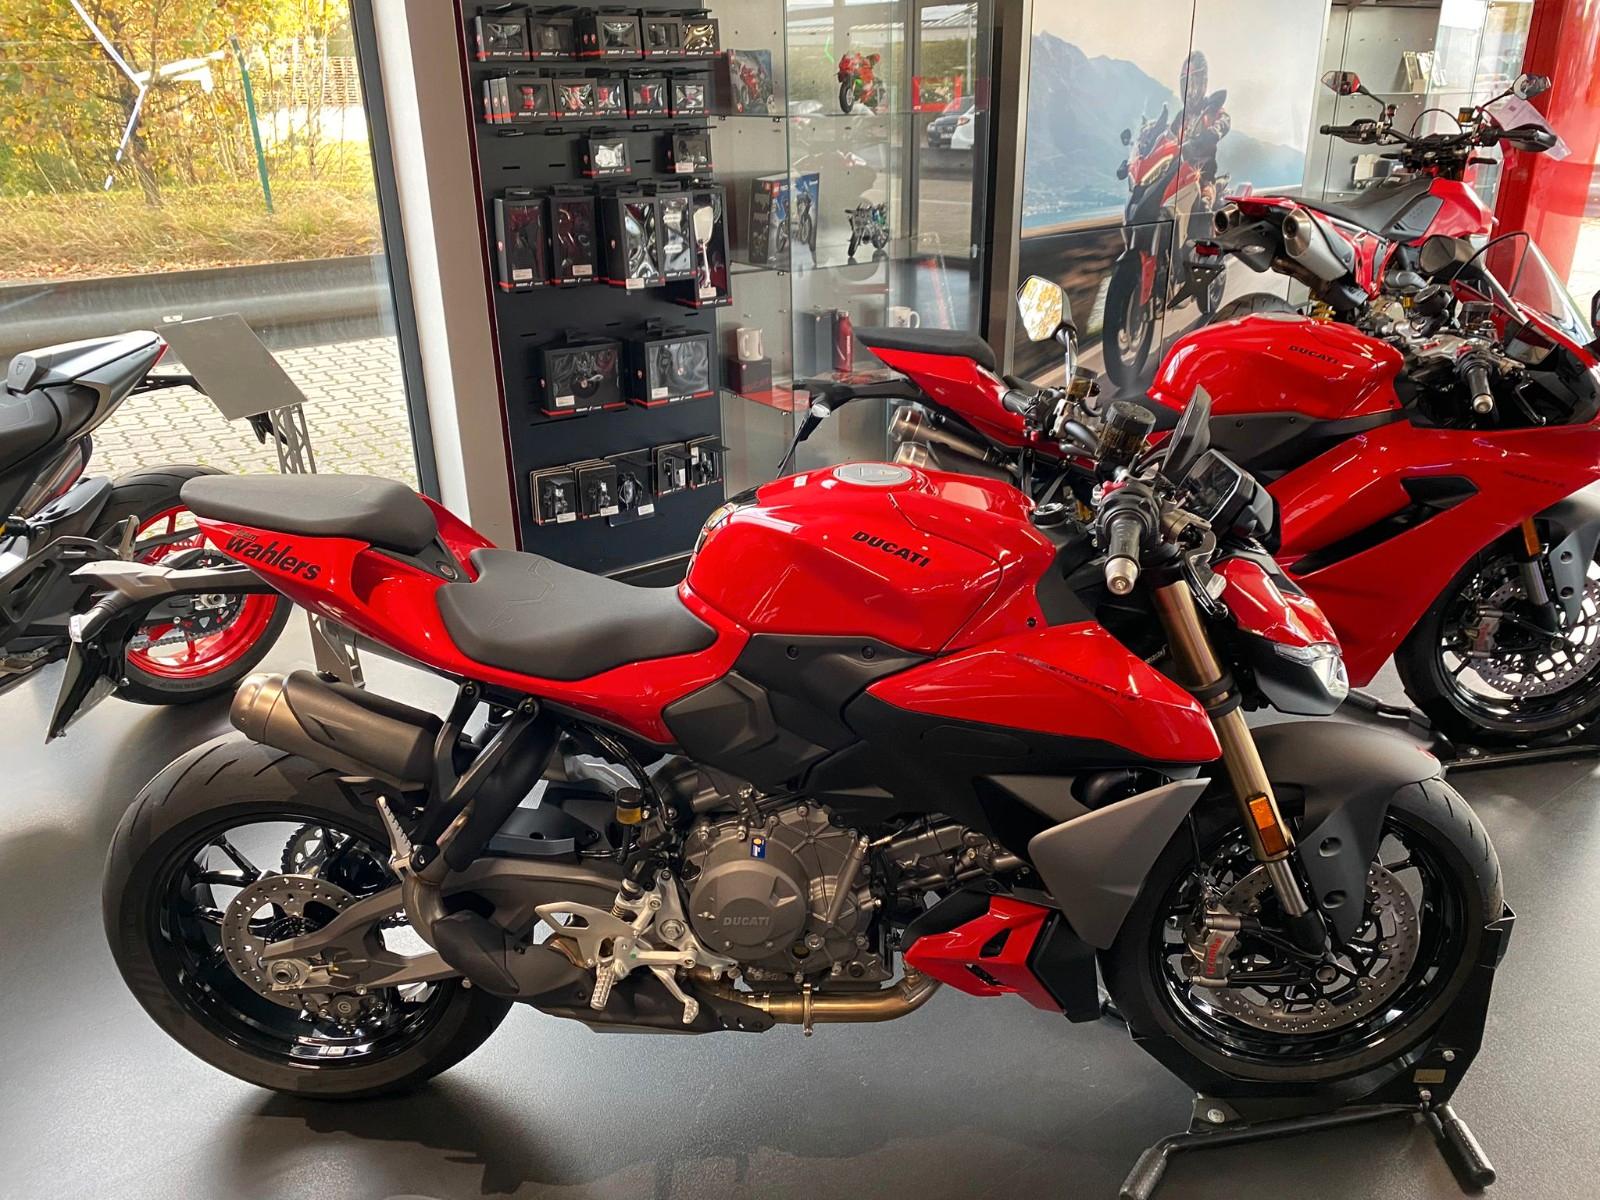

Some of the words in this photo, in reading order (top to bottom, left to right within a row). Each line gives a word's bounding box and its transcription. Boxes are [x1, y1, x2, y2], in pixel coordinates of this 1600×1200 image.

[1289, 345, 1340, 364] DUCATI
[851, 531, 931, 567] DUCATI
[723, 916, 770, 926] DUCATI
